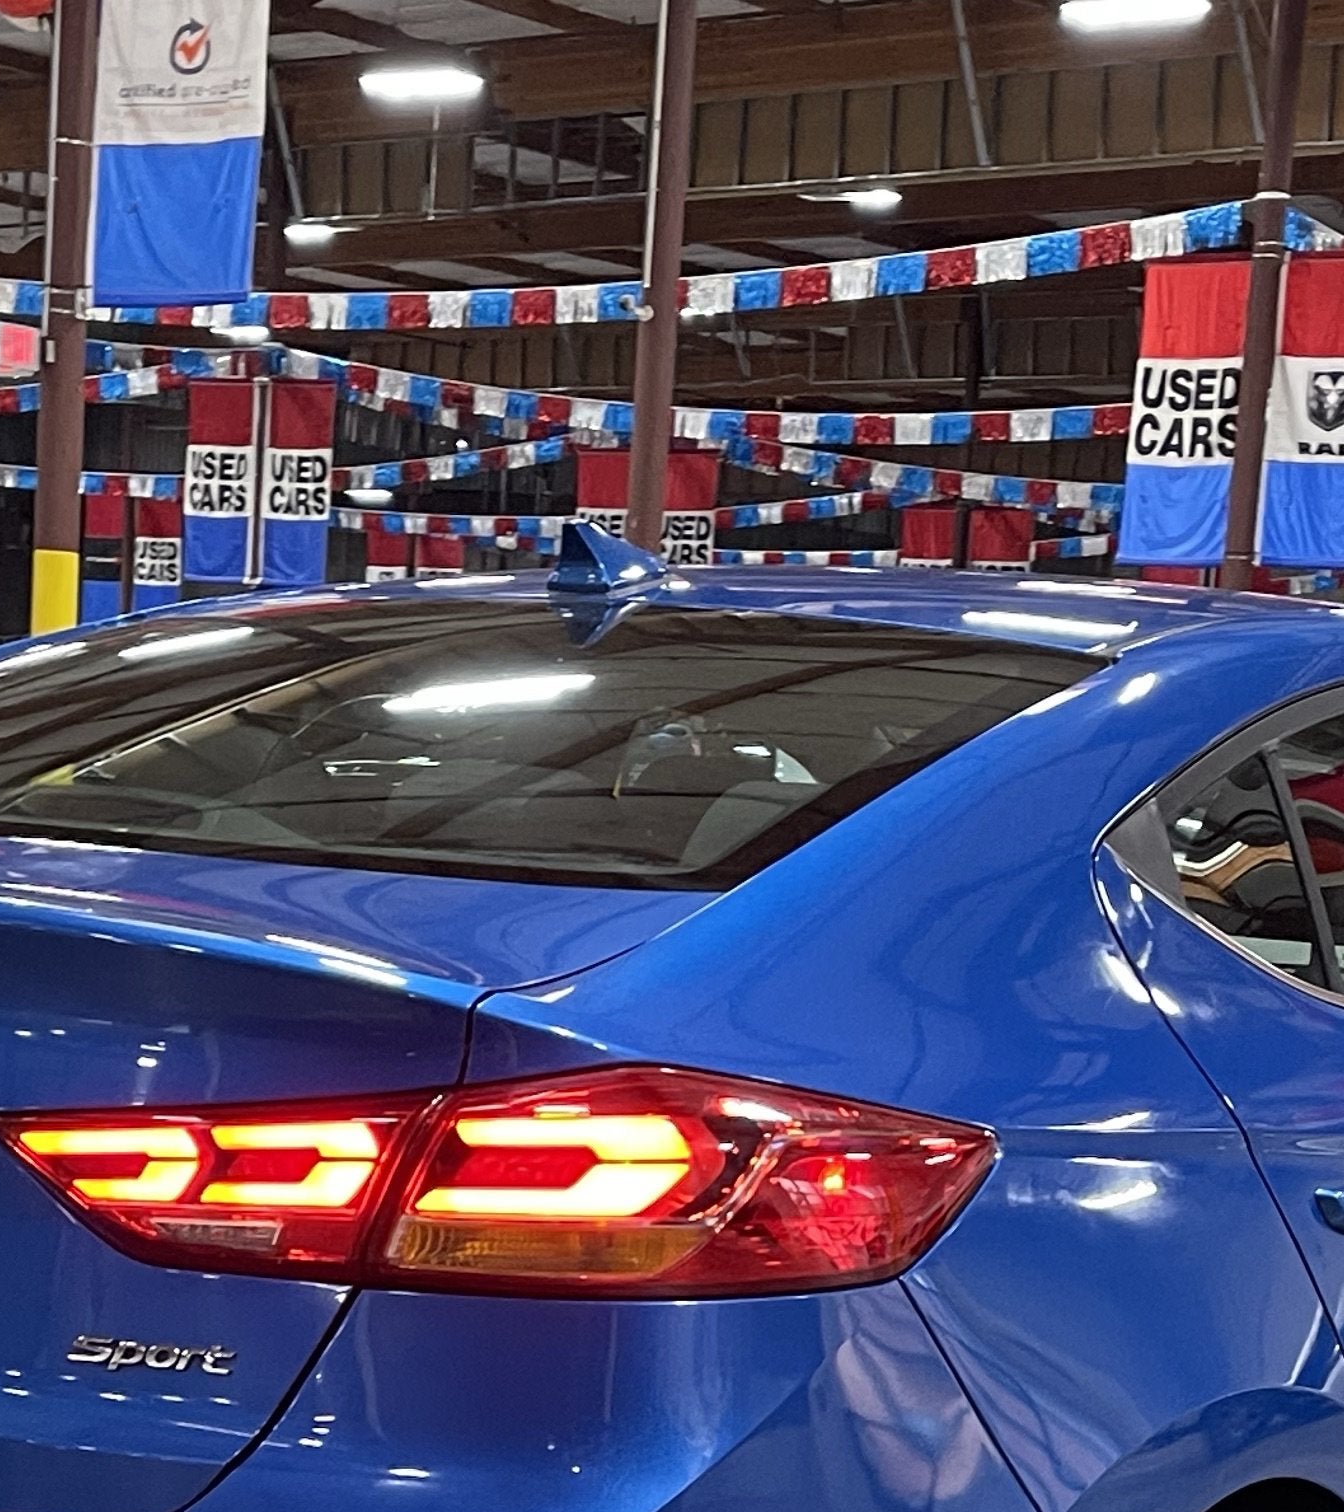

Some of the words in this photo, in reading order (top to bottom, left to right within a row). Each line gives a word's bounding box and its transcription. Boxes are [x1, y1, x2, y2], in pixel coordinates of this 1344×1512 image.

[1142, 367, 1241, 411] USED
[1135, 413, 1236, 457] CARS
[192, 451, 248, 480] USED
[189, 482, 247, 512] CARS
[268, 485, 327, 515] CARS
[67, 1335, 236, 1375] Sport
